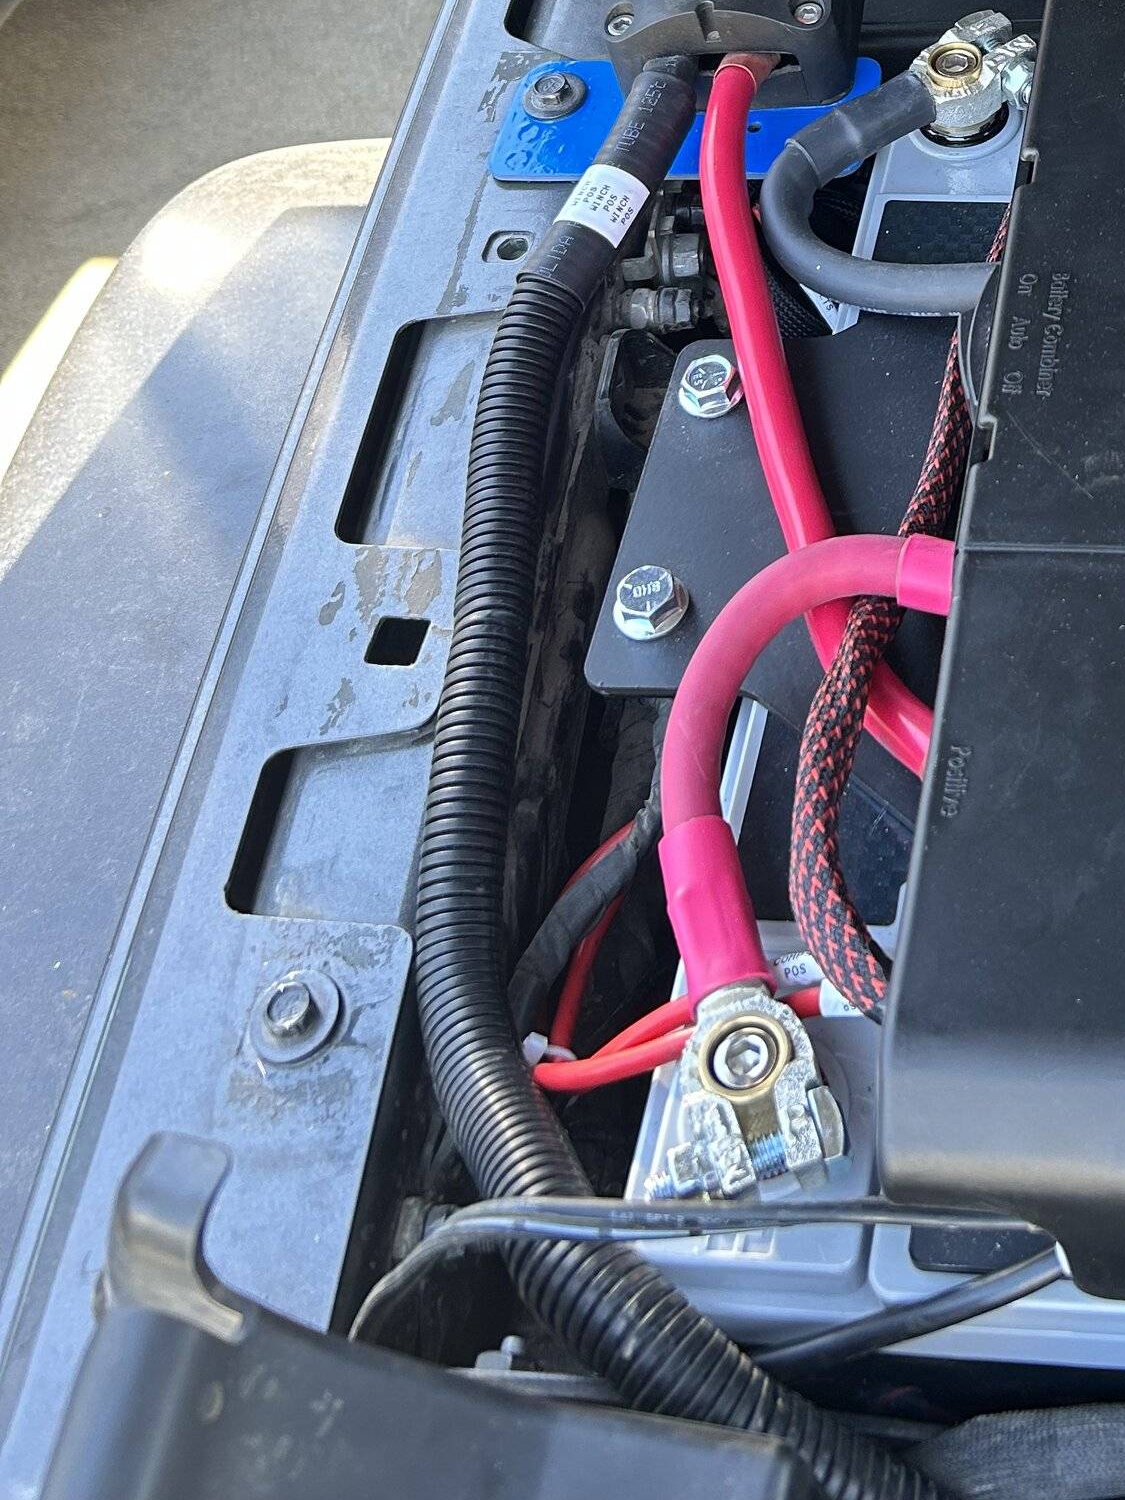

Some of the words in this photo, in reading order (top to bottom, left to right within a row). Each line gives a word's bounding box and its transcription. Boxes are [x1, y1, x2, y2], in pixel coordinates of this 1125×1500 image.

[583, 185, 597, 204] POS
[591, 184, 611, 212] WINCH
[603, 194, 618, 212] POS
[610, 194, 630, 223] WINCH
[621, 206, 635, 225] POS
[1017, 273, 1038, 295] On
[1008, 316, 1031, 350] Auto
[1036, 324, 1064, 397] Combiner
[1002, 370, 1024, 395] Off
[939, 744, 973, 819] Positive
[783, 963, 806, 979] POS
